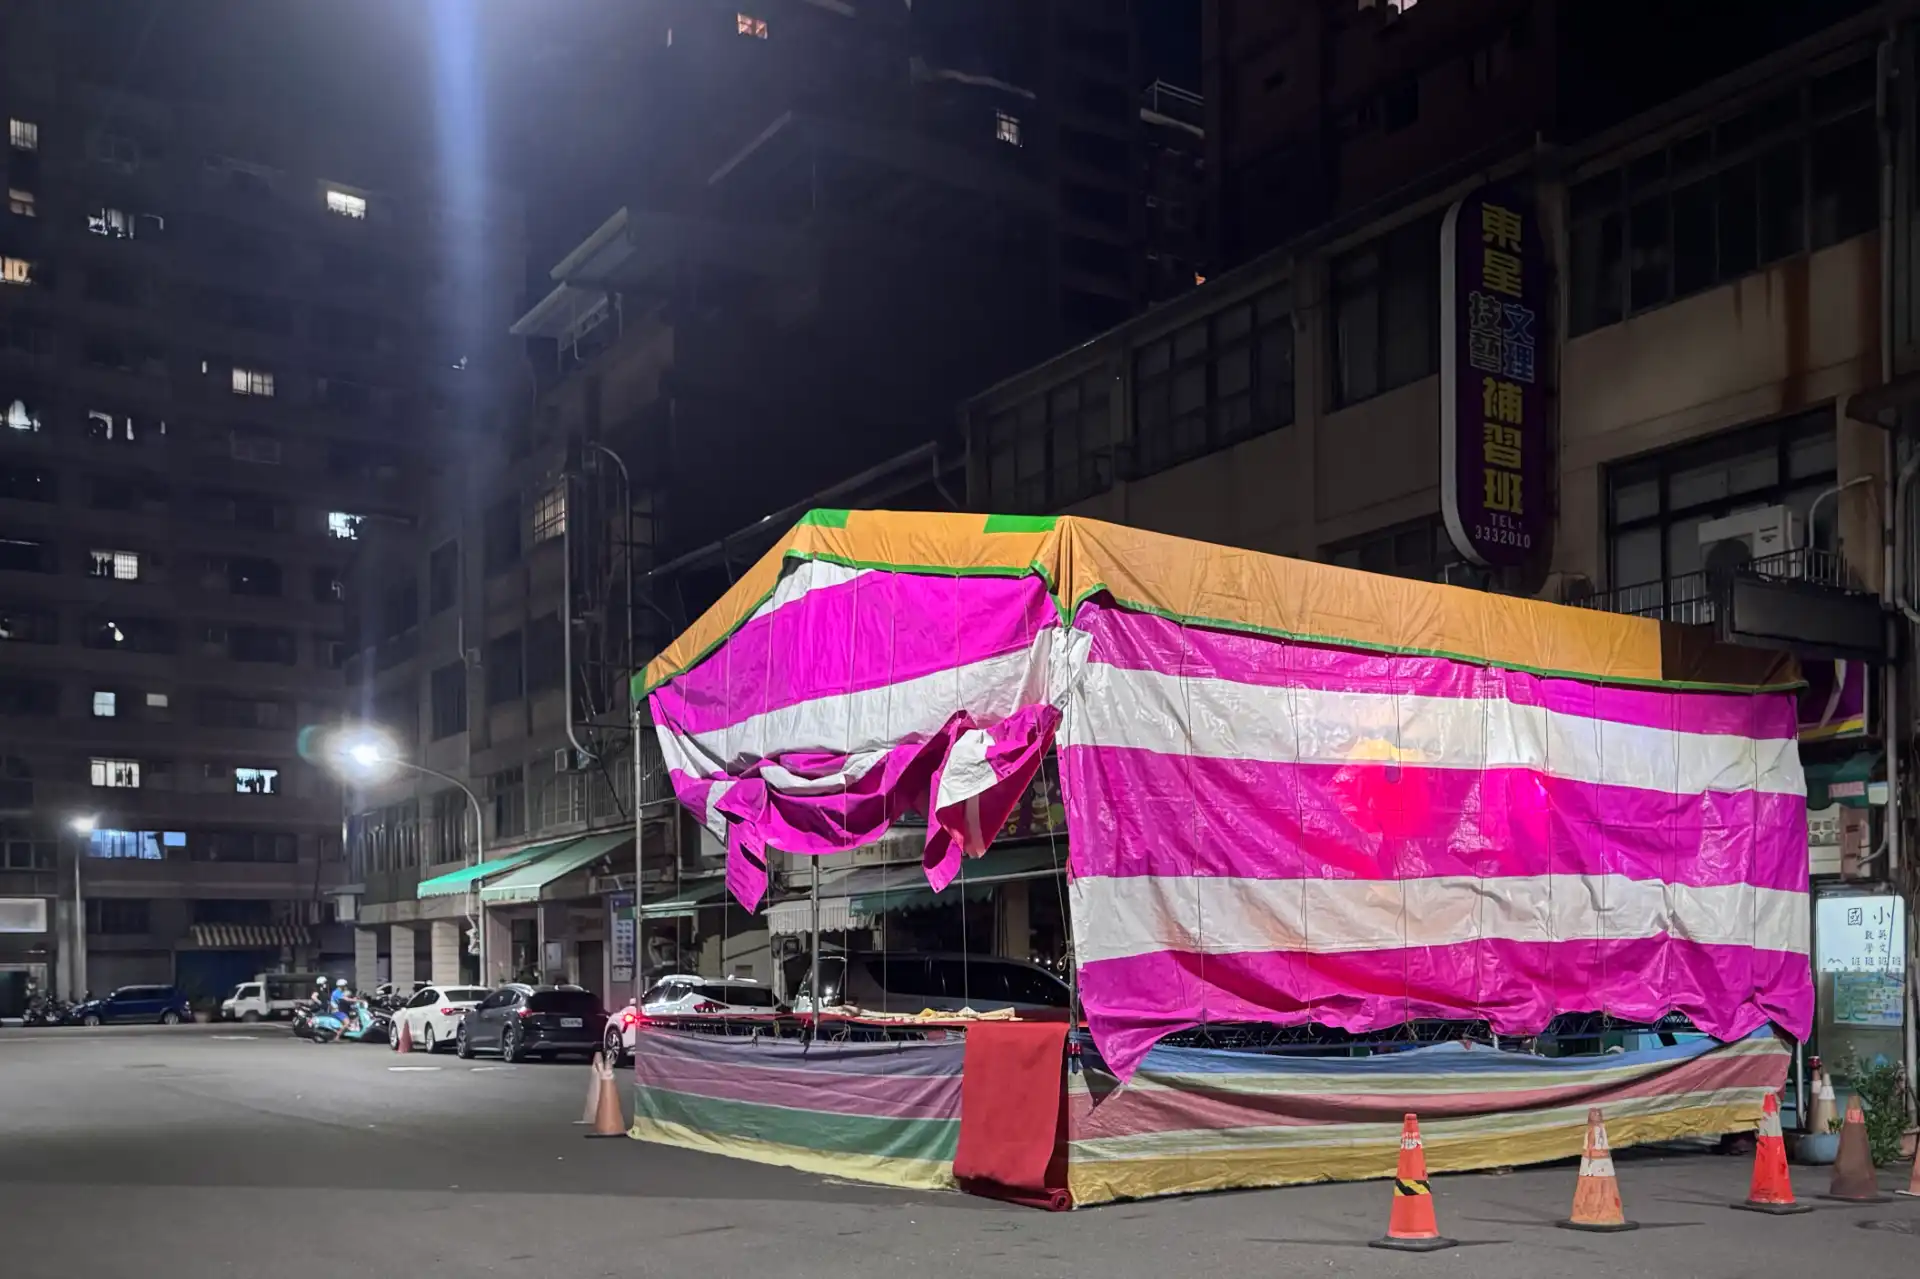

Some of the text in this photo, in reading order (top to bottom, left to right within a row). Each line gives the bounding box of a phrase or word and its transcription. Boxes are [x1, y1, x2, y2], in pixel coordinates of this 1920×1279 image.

[1481, 201, 1523, 298] 東星
[1502, 303, 1536, 384] 文理
[1482, 375, 1524, 515] 補習班
[1474, 524, 1531, 549] 3332010
